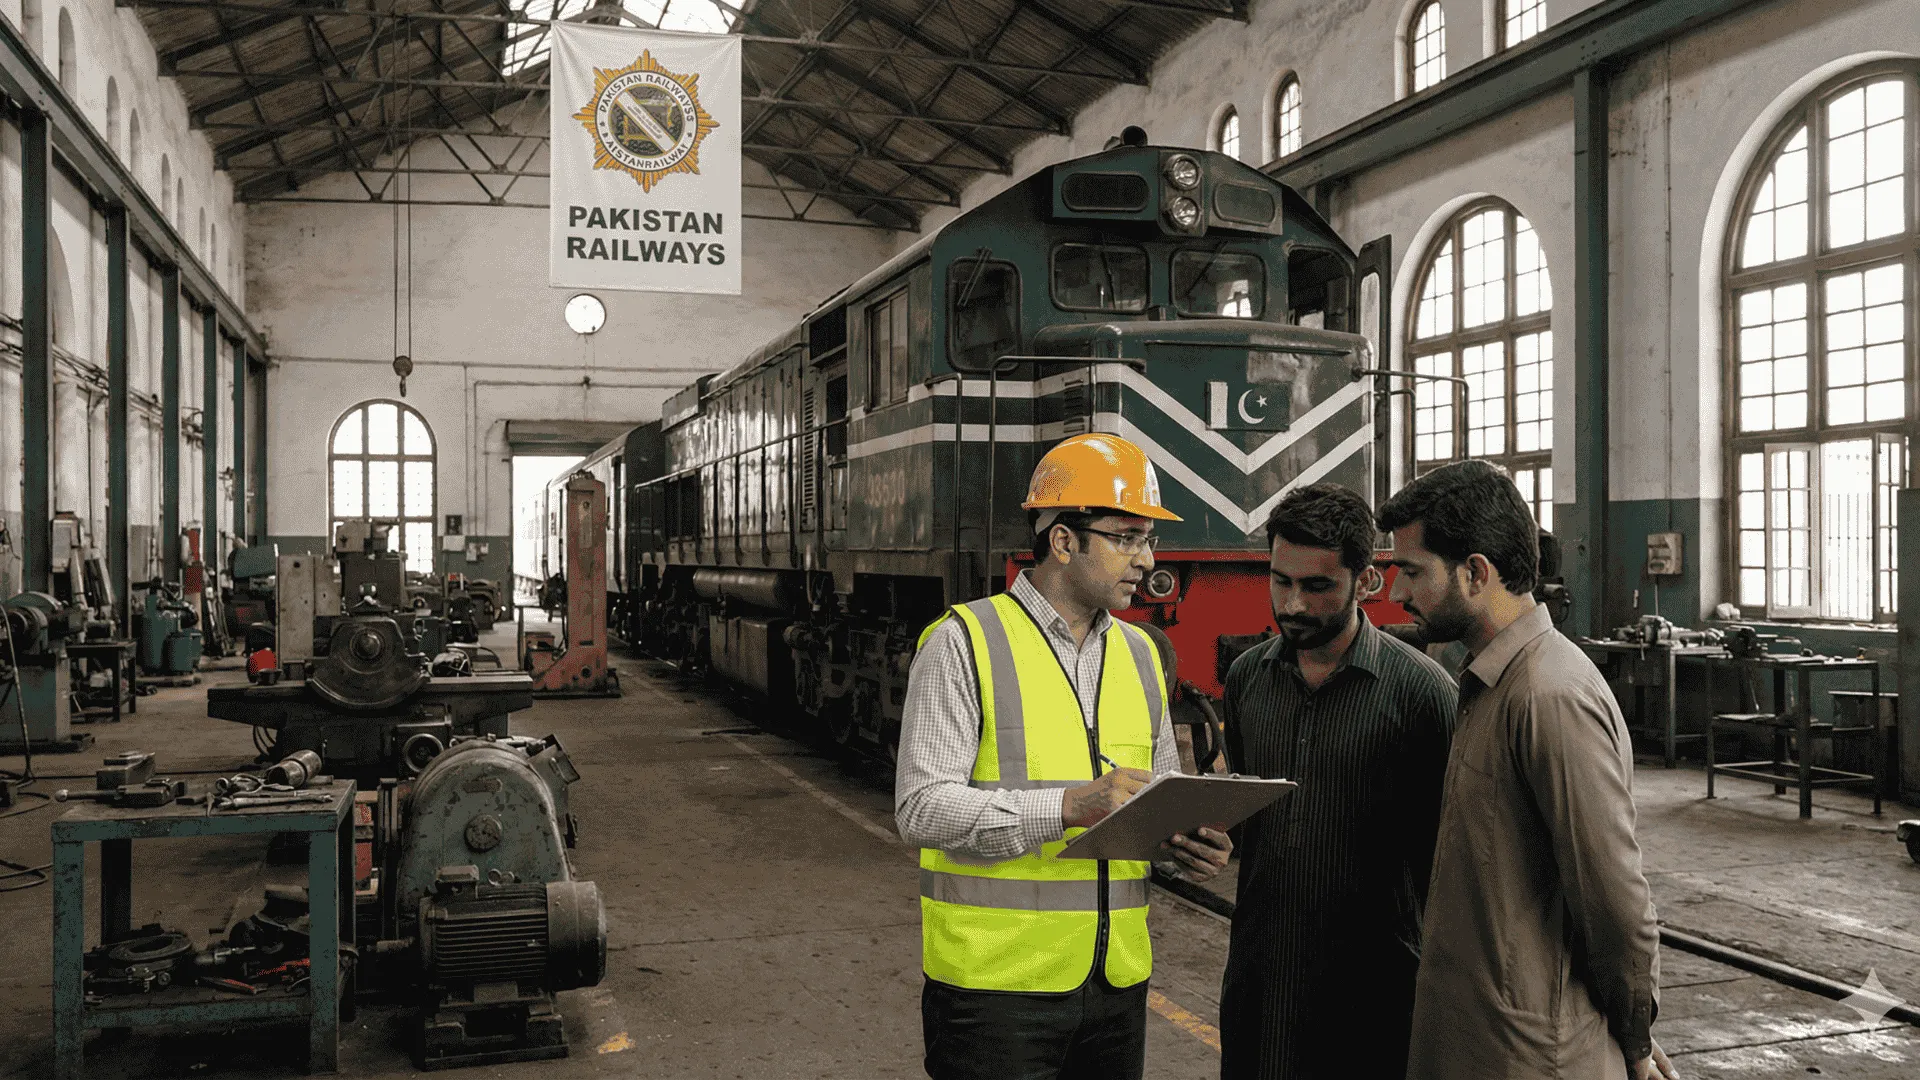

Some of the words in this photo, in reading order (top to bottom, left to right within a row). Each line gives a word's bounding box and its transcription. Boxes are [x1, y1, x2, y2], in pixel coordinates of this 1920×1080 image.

[599, 74, 642, 113] PAKISTAN
[569, 206, 723, 235] PAKISTAN
[567, 237, 726, 266] RAILWAYS
